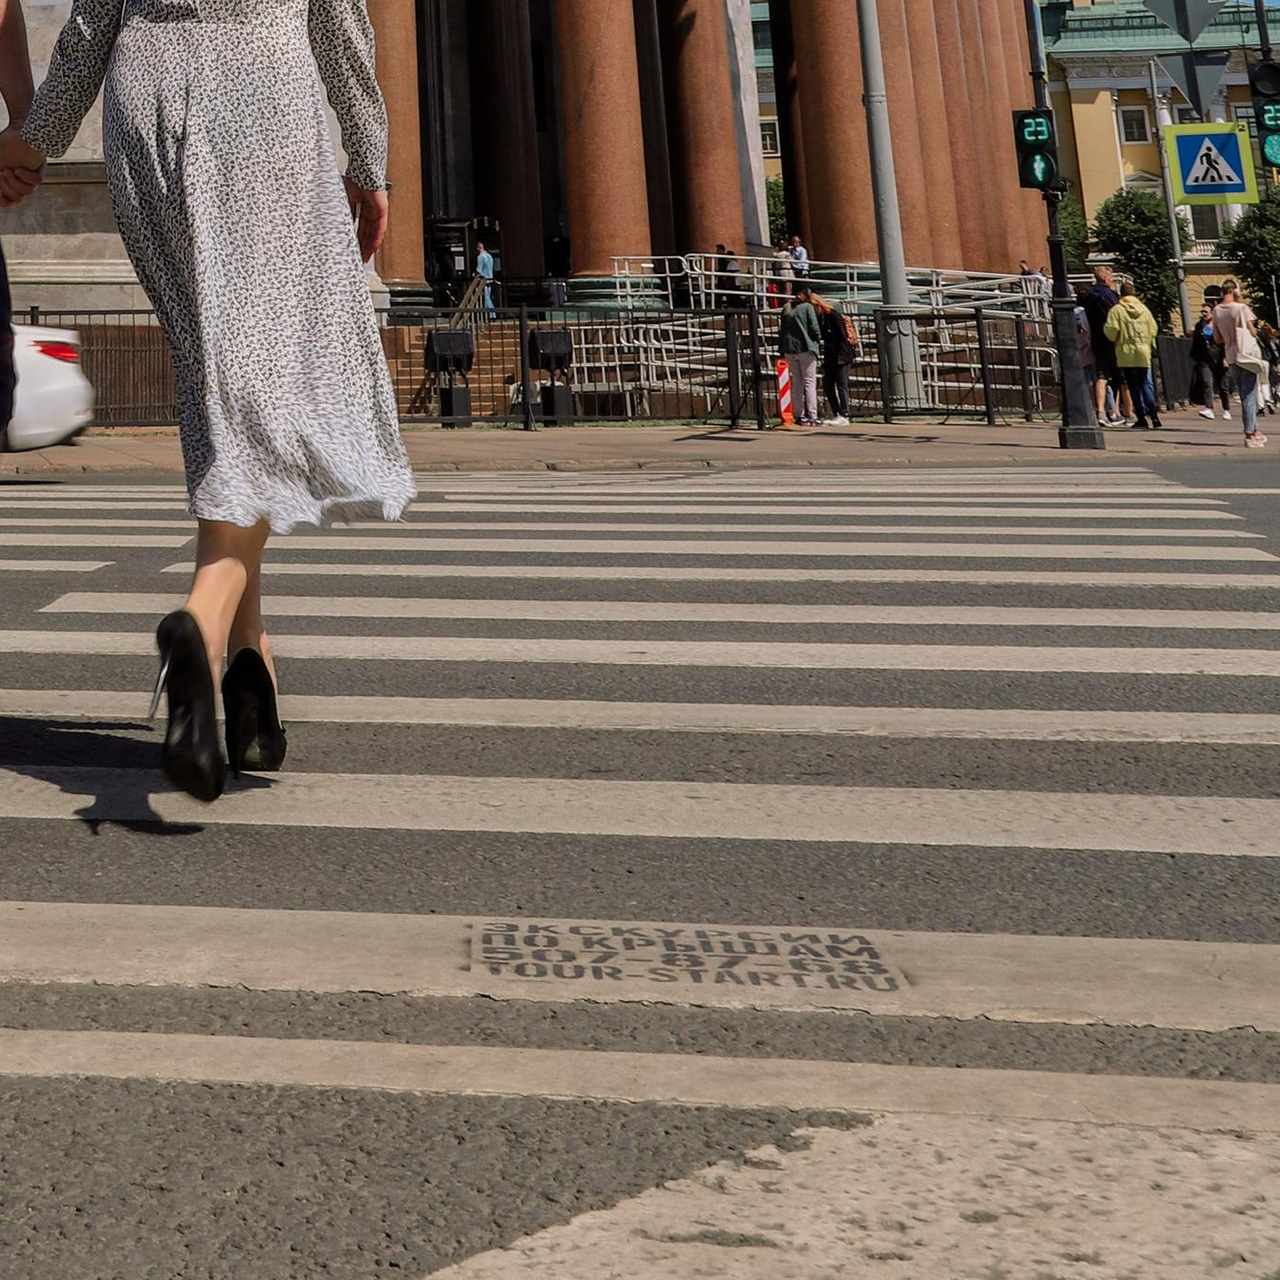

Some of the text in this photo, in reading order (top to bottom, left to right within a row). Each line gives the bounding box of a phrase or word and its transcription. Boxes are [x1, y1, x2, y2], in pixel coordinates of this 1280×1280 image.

[1023, 118, 1049, 140] 23
[482, 933, 880, 959] ПО КРЫШАМ
[483, 922, 872, 945] ЭКСКУРСИИ
[483, 946, 889, 975] 507-87-68
[483, 961, 899, 991] TOUR-START.RU
